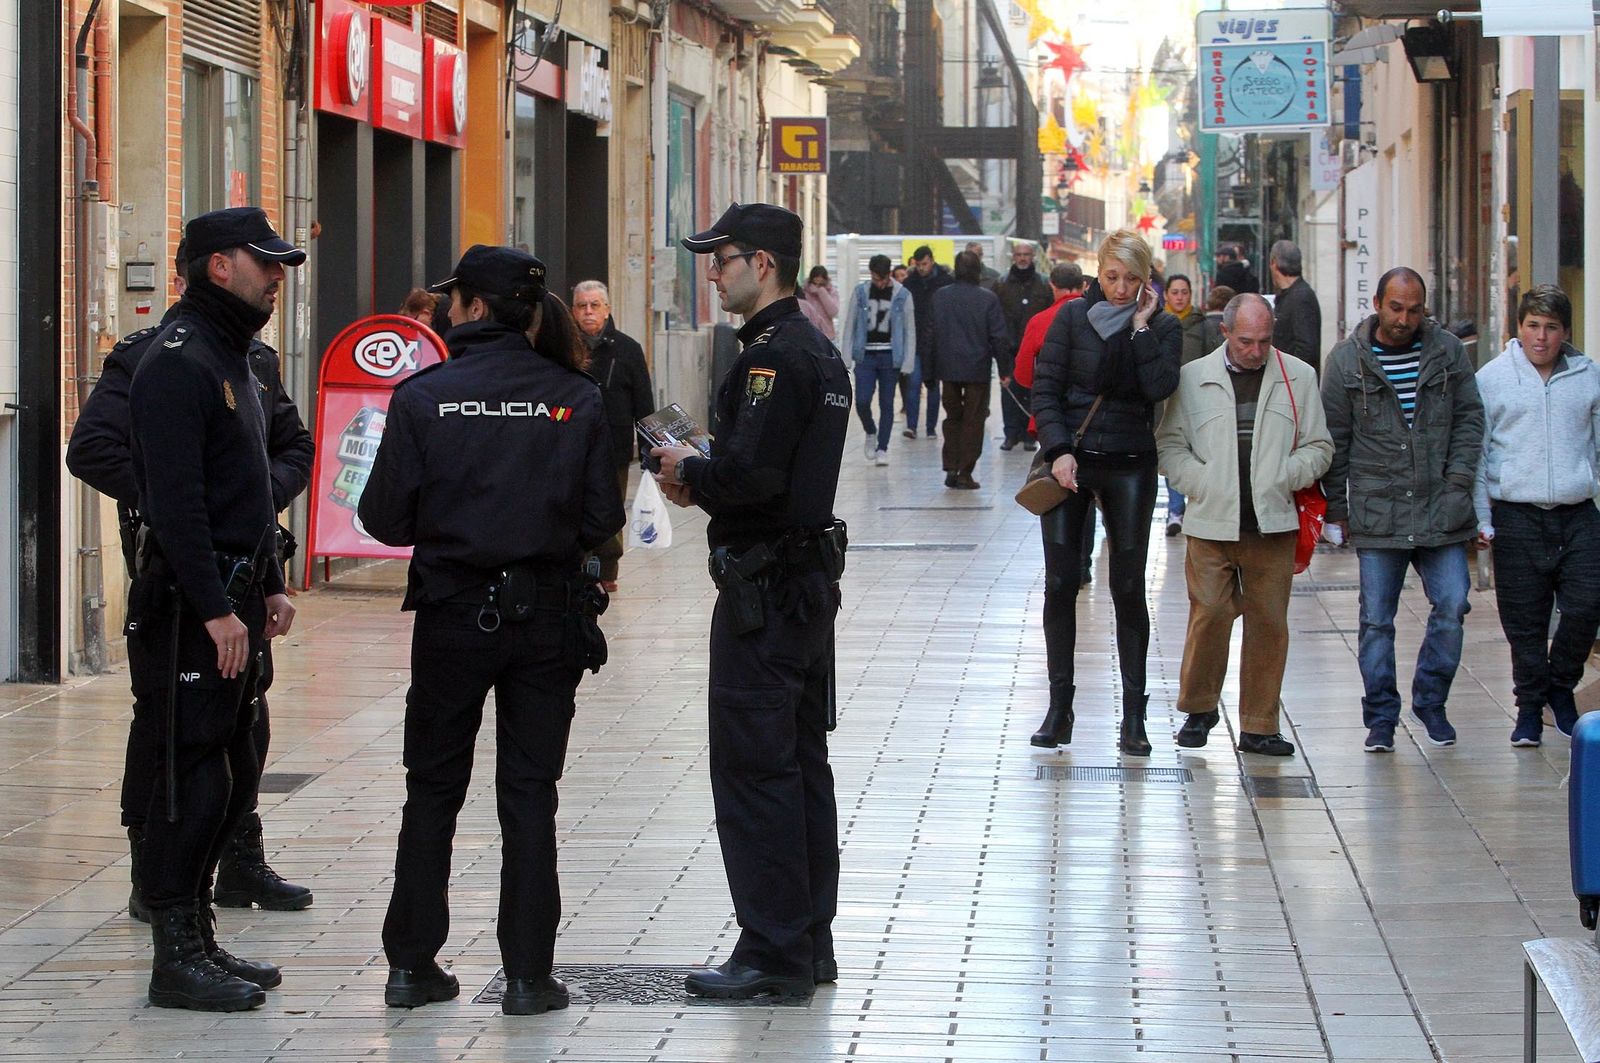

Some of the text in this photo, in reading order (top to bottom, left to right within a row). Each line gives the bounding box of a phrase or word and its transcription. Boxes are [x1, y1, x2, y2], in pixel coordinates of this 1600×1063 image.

[1217, 18, 1279, 39] viajes
[779, 162, 821, 171] TABACOS
[1357, 208, 1370, 321] PLATER
[824, 392, 849, 408] POLICIA
[438, 401, 551, 417] POLICIA
[345, 439, 377, 457] MÓV
